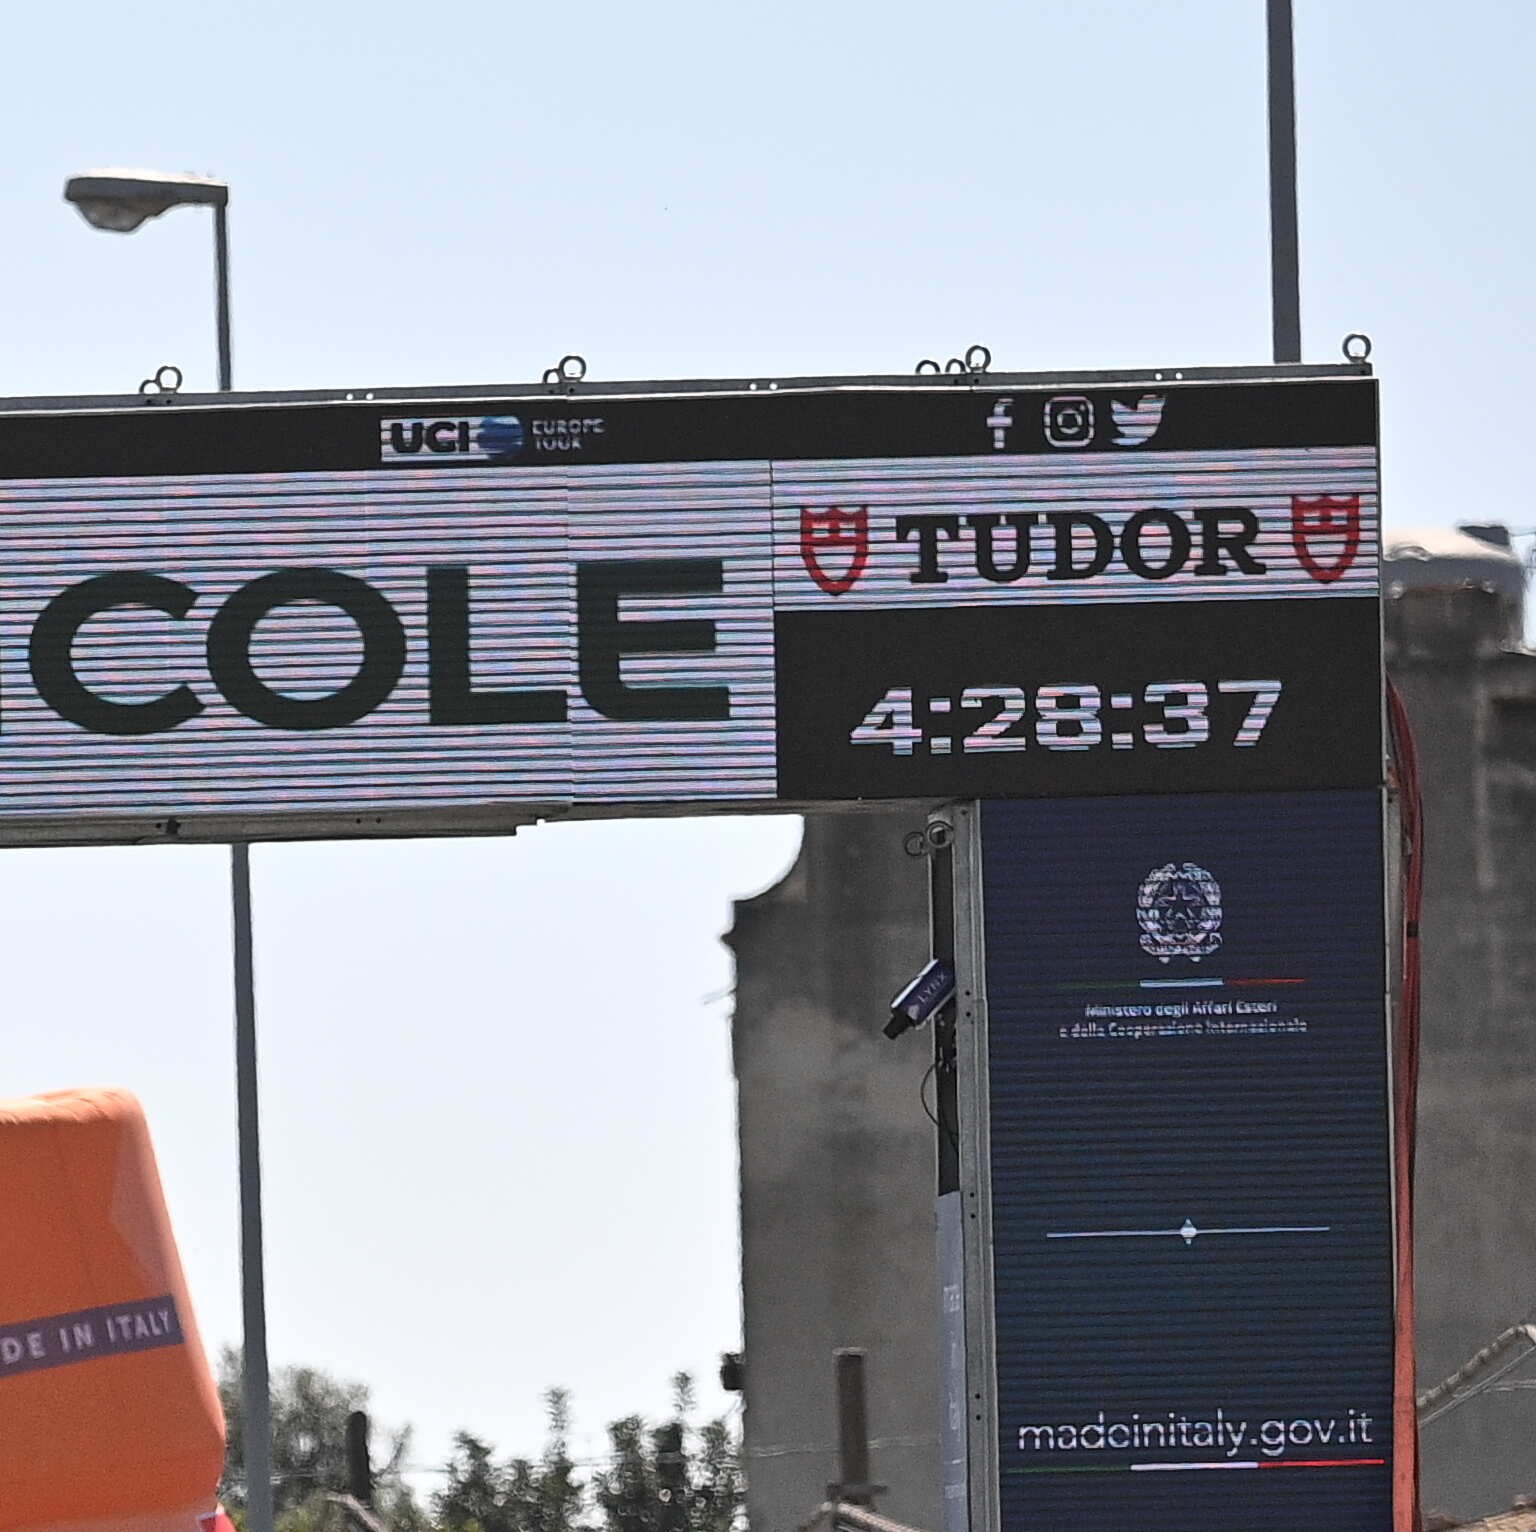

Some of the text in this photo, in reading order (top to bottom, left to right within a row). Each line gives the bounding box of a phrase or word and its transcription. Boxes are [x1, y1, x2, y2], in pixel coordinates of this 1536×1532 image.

[391, 420, 471, 454] UCI
[894, 506, 1268, 584] TUDOR
[849, 679, 1283, 756] 4:28:37
[58, 1323, 95, 1353] IN
[105, 1309, 171, 1344] ITALY
